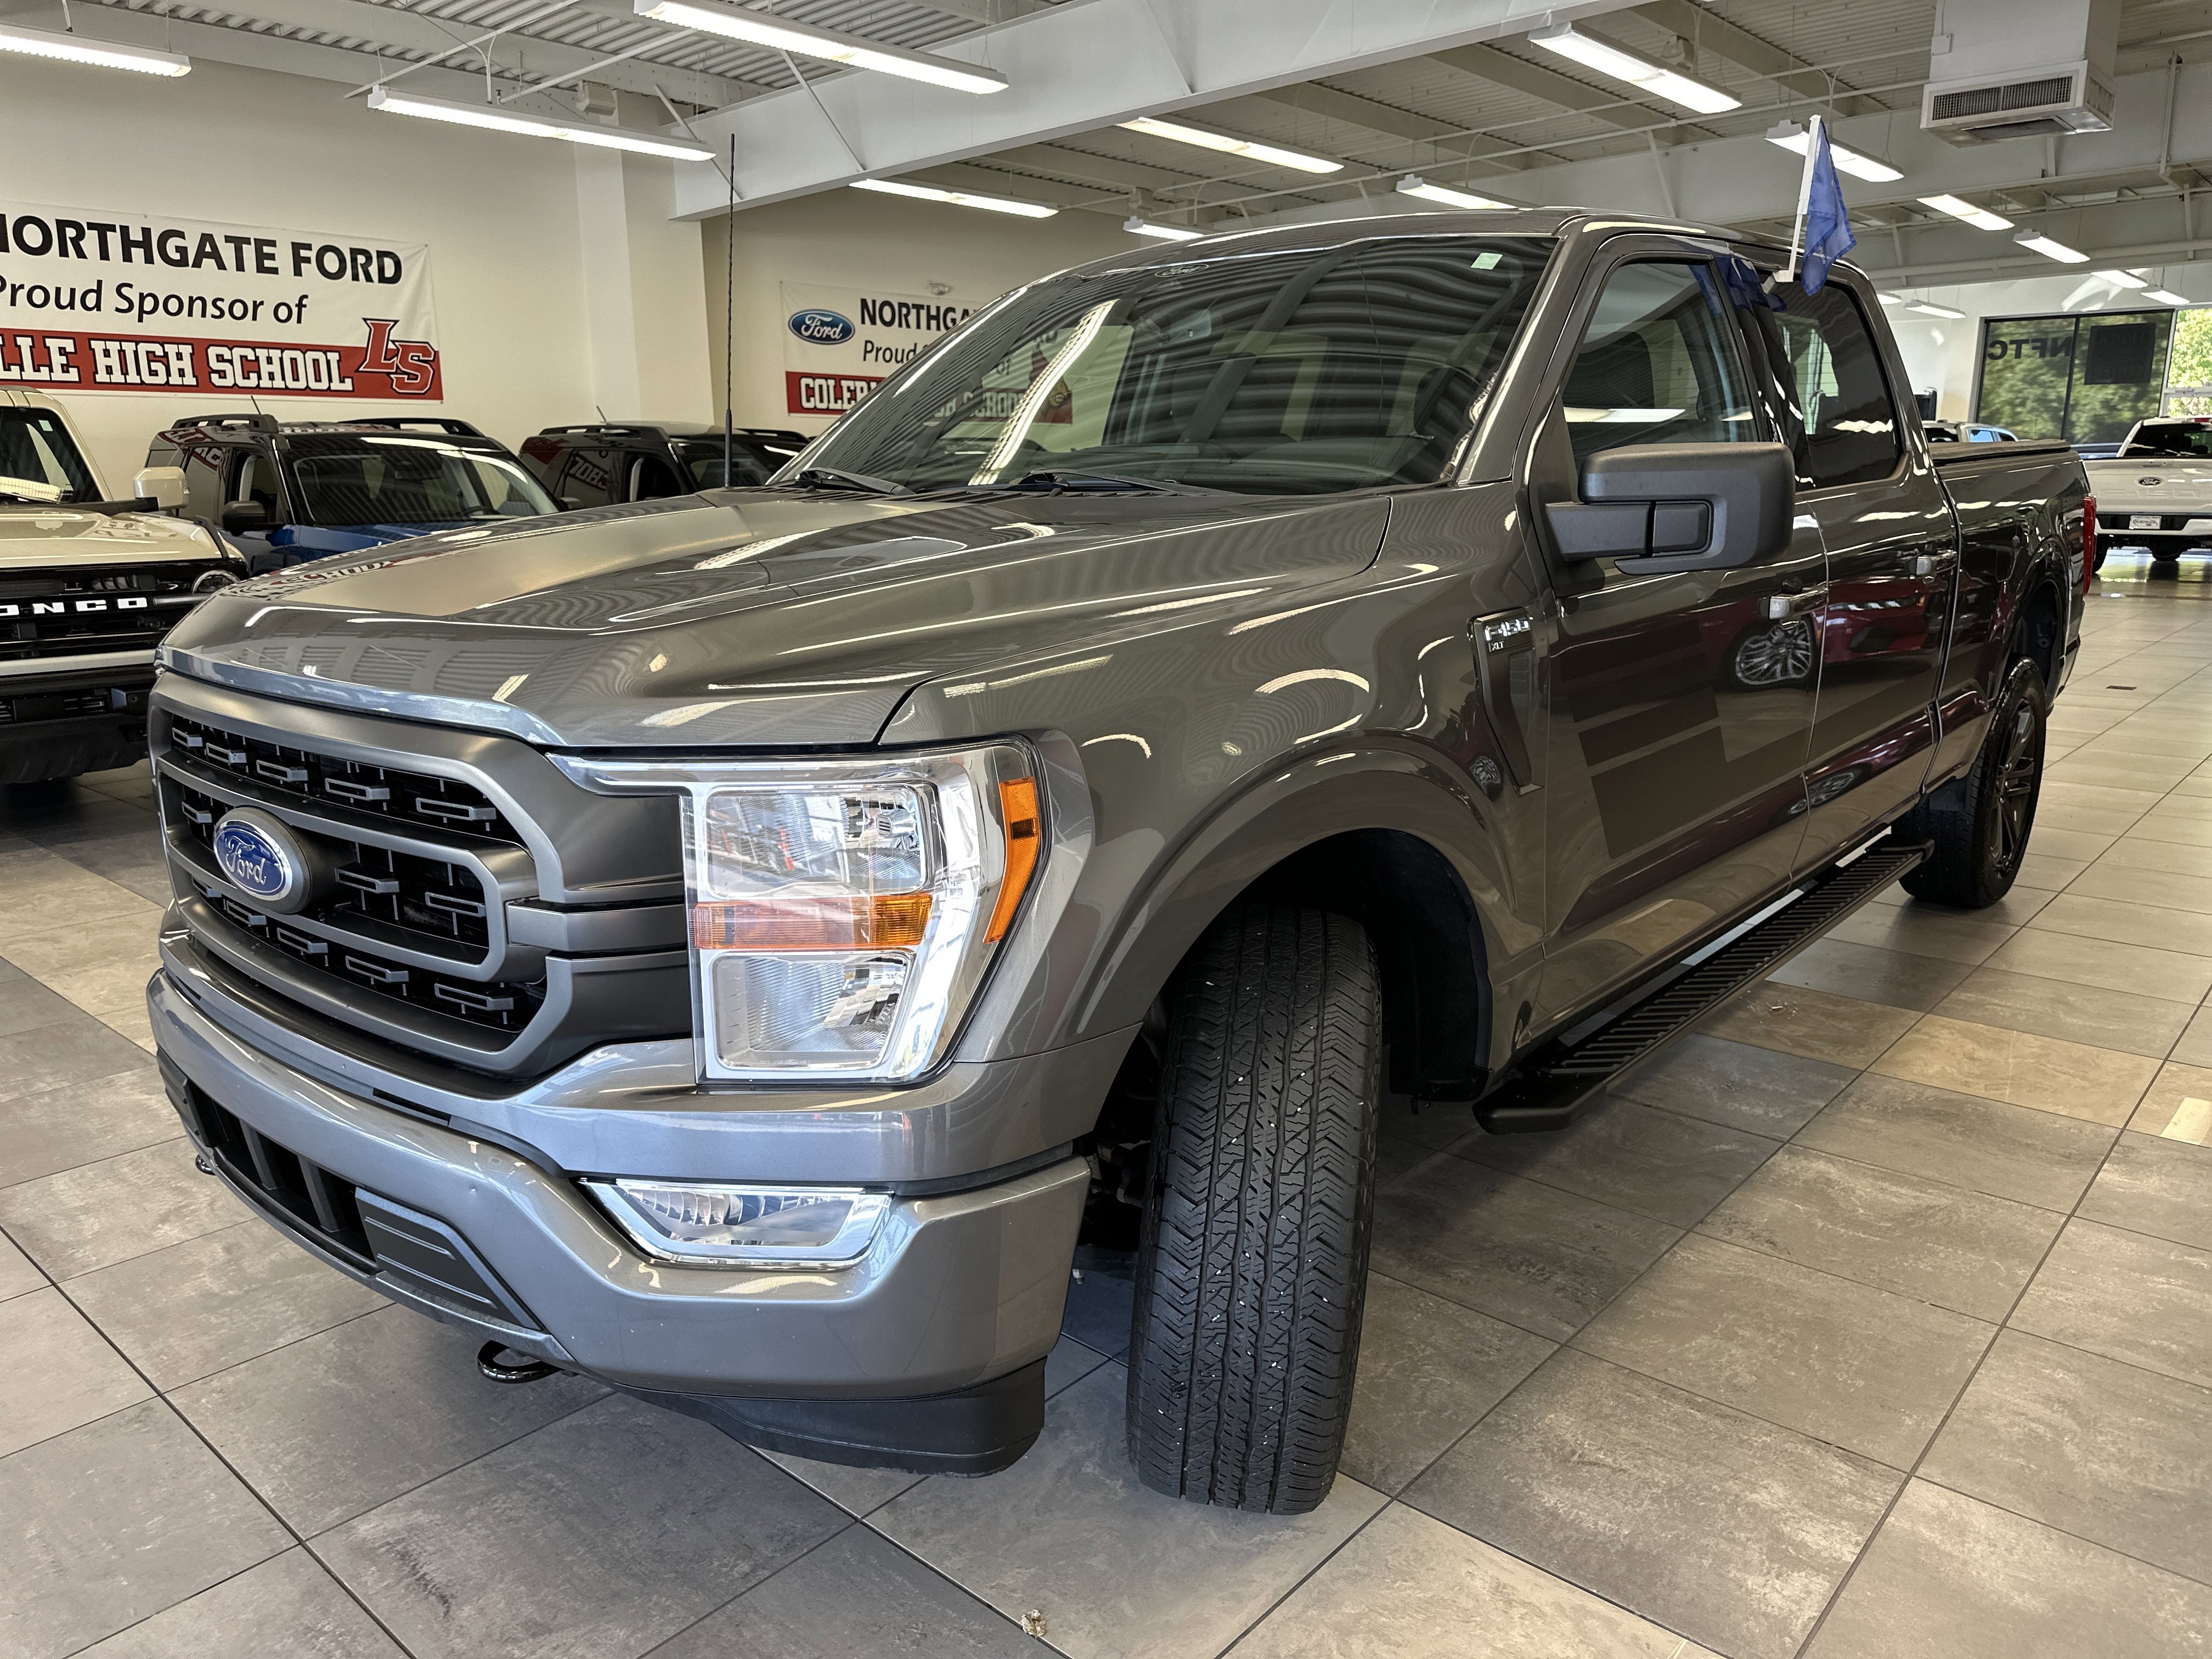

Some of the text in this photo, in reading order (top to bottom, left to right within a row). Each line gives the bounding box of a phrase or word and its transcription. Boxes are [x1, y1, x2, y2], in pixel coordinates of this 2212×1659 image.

[291, 241, 402, 285] FORD
[114, 282, 264, 323] Sponsor
[273, 294, 309, 324] of
[800, 313, 844, 340] Ford
[89, 339, 197, 386] HIGH
[207, 345, 354, 393] SCHOOL
[355, 318, 438, 394] LS
[1491, 641, 1504, 651] XLT
[224, 835, 267, 885] Ford
